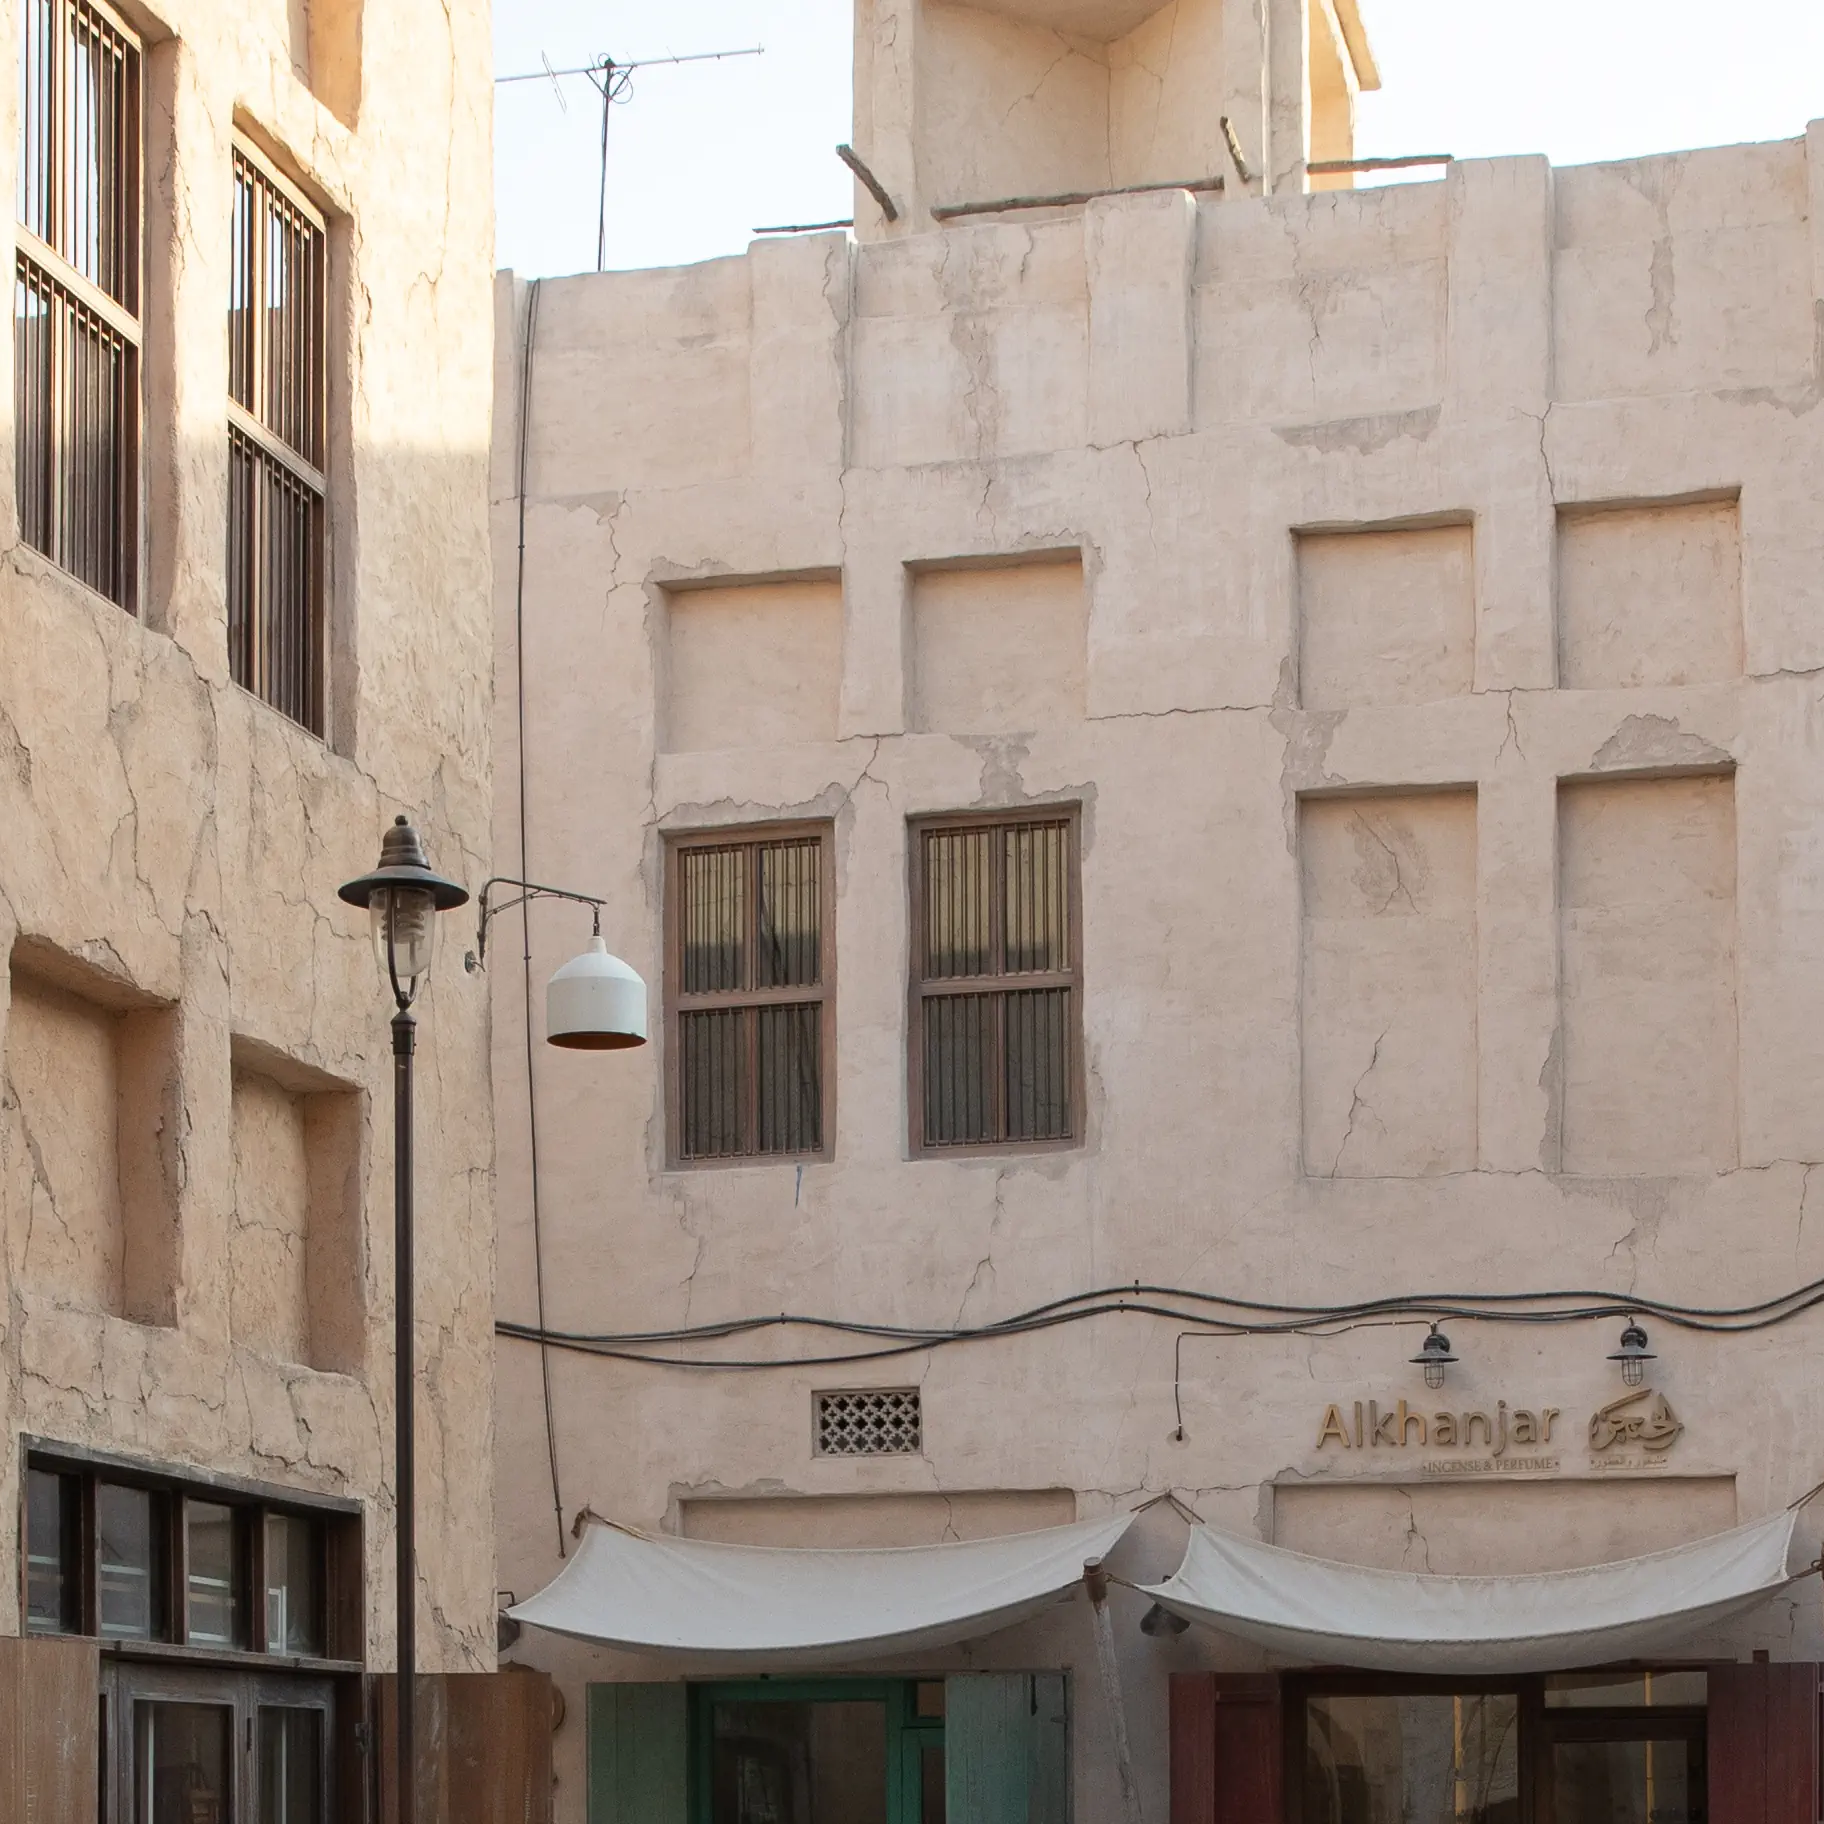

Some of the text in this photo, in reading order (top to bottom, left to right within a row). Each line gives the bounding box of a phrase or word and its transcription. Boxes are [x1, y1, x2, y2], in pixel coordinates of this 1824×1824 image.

[1316, 1398, 1560, 1458] Alkhanjar
[1427, 1457, 1553, 1473] INCENSE & PERFUME
